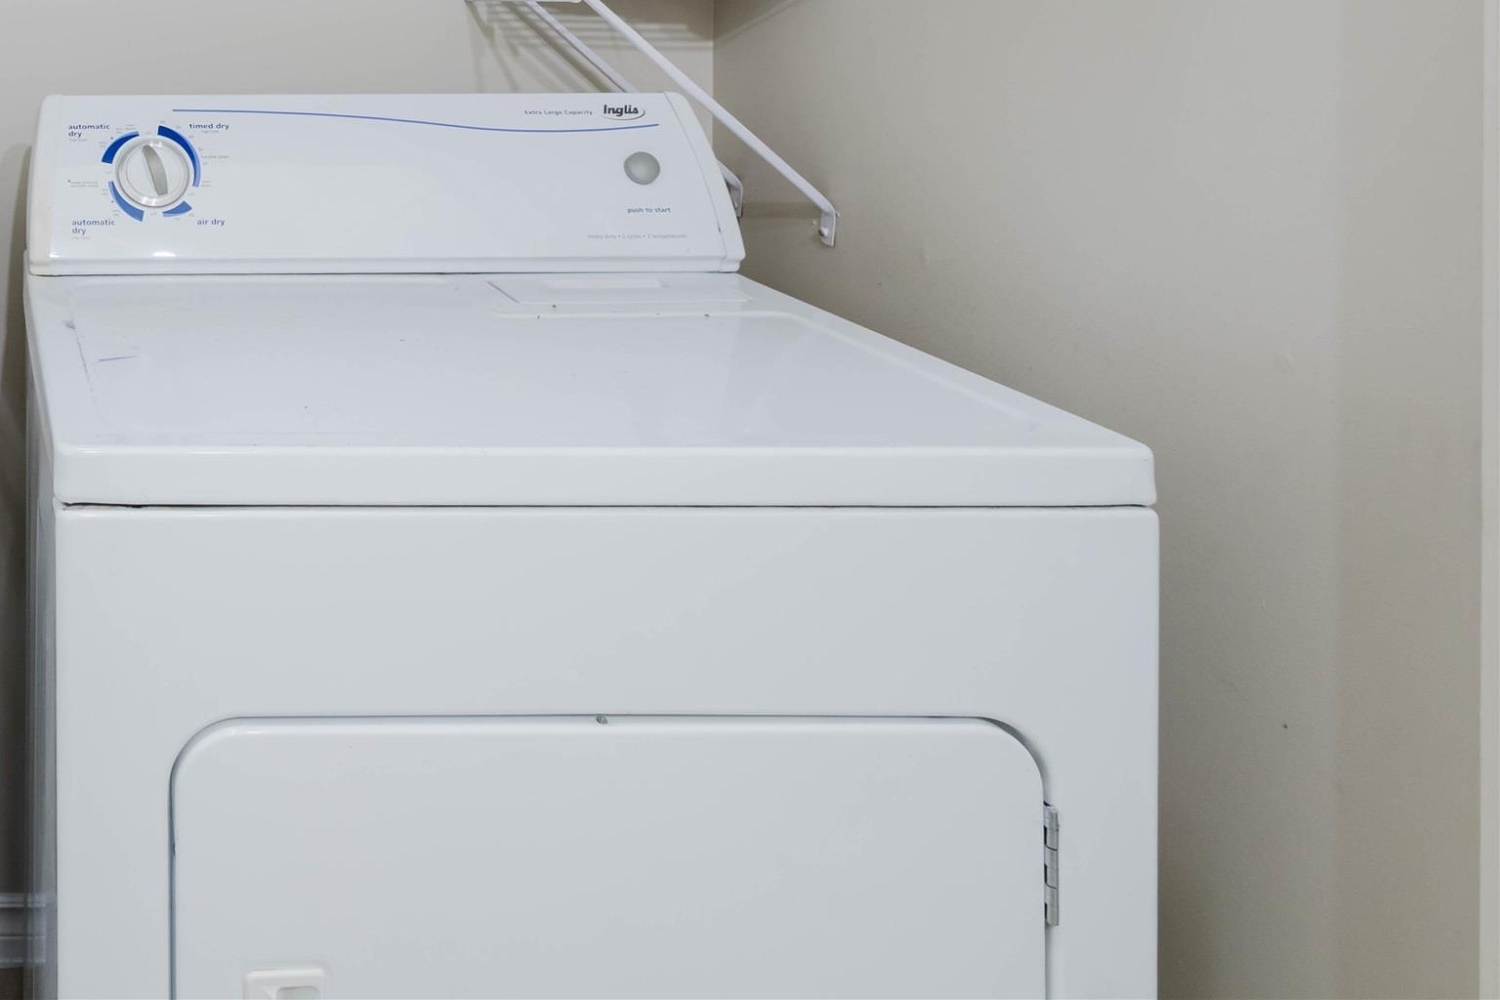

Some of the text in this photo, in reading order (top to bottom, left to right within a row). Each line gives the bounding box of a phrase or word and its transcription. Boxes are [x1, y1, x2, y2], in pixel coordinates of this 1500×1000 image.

[603, 104, 640, 117] Inglis
[215, 123, 230, 131] dry
[71, 219, 116, 227] automatic
[211, 219, 226, 228] dry
[71, 227, 87, 236] dry
